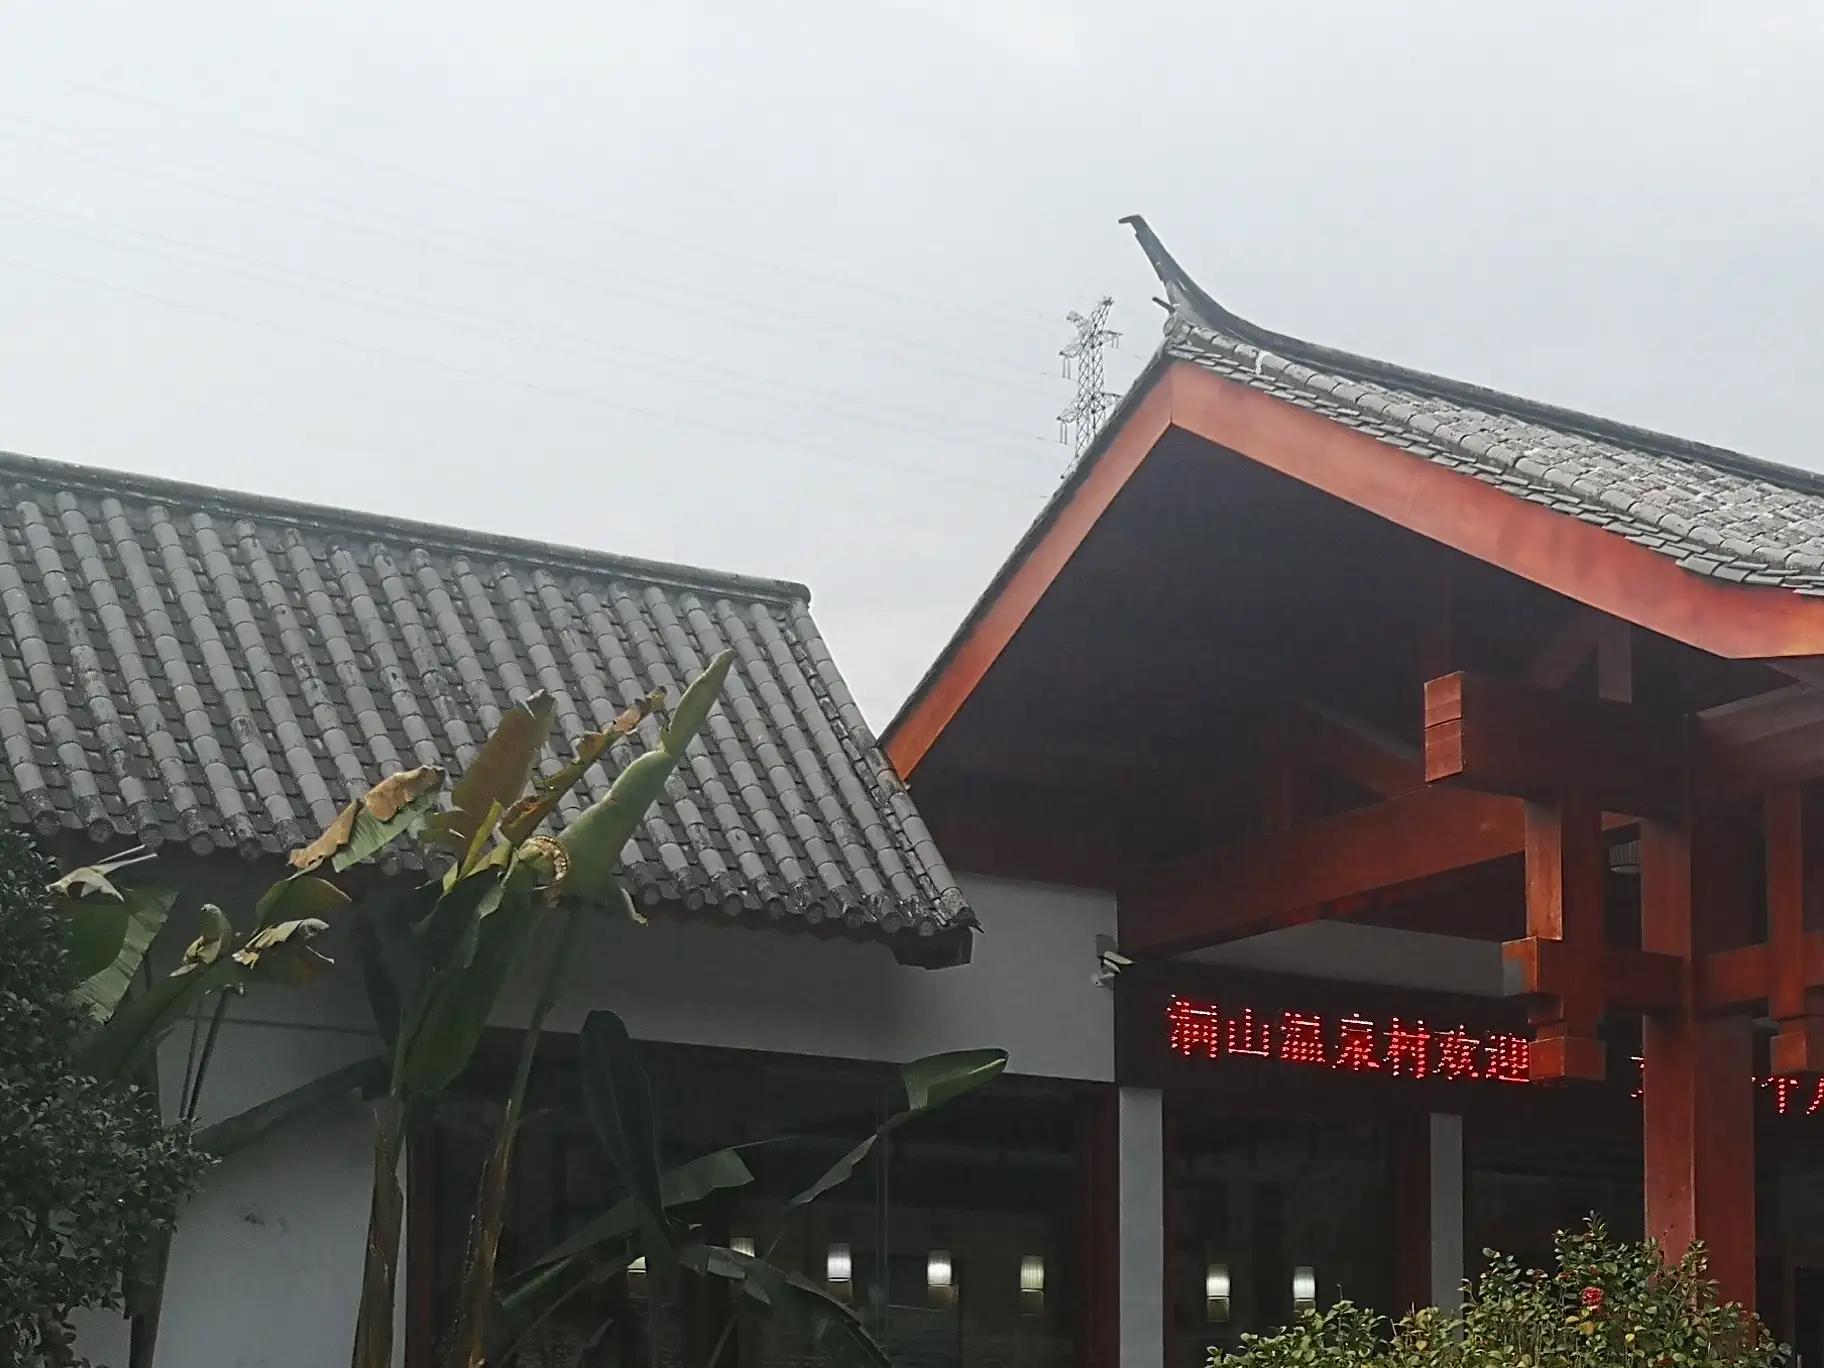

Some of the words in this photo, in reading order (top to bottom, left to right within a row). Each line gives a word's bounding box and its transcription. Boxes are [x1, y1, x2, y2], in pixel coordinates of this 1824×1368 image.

[1166, 994, 1531, 1082] 洞山温泉村欢迎
